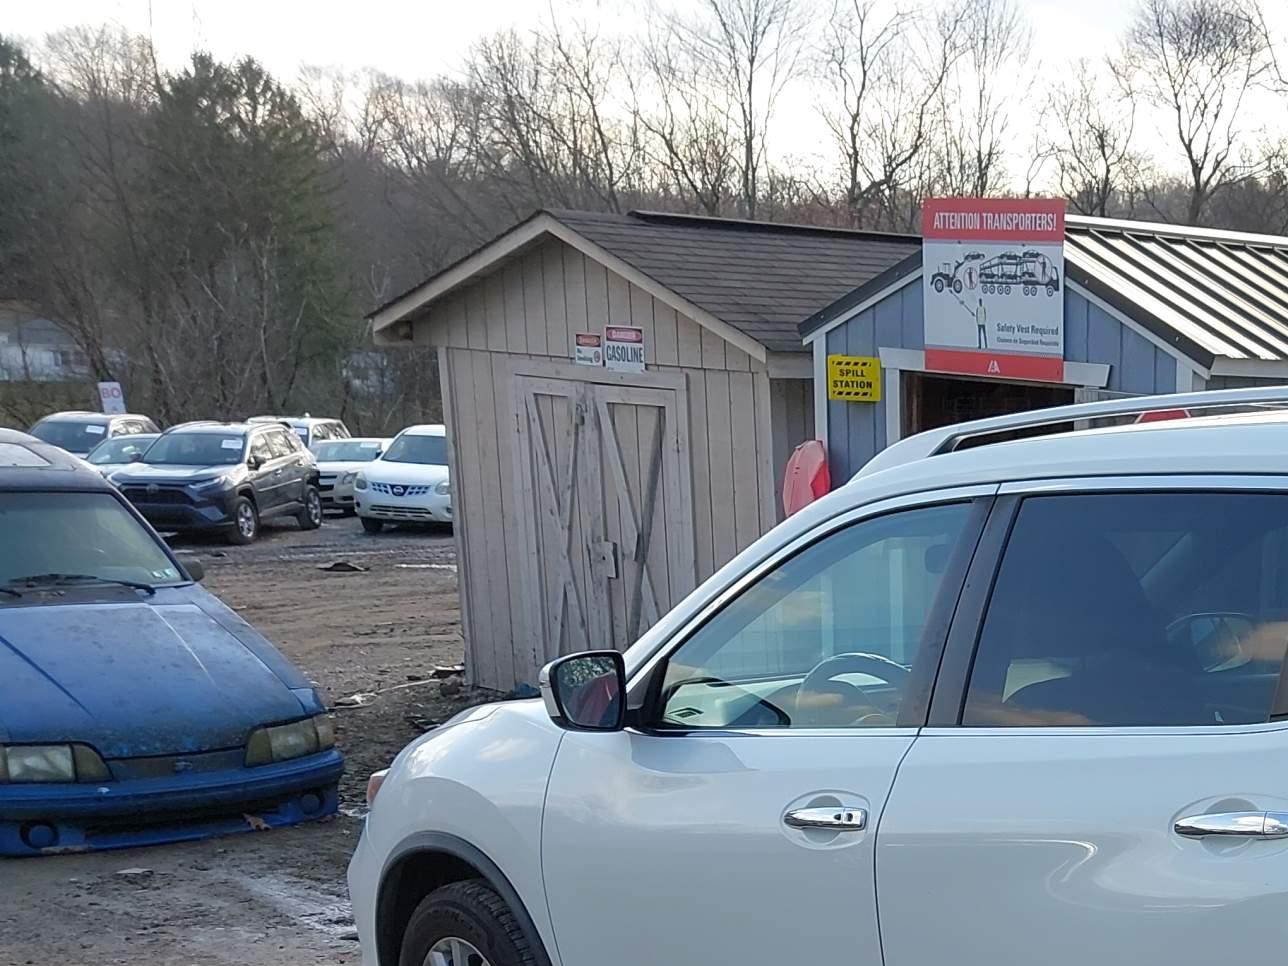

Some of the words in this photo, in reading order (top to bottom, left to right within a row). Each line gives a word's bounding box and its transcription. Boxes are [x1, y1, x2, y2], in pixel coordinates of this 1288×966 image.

[934, 212, 980, 230] ATTENTION
[983, 213, 1057, 231] TRANSPORTERS!
[997, 322, 1015, 334] Safety
[1016, 324, 1030, 334] Vest
[1031, 325, 1059, 336] Required
[606, 345, 643, 363] GASOLINE
[839, 368, 866, 377] SPILL
[832, 380, 873, 389] STATION
